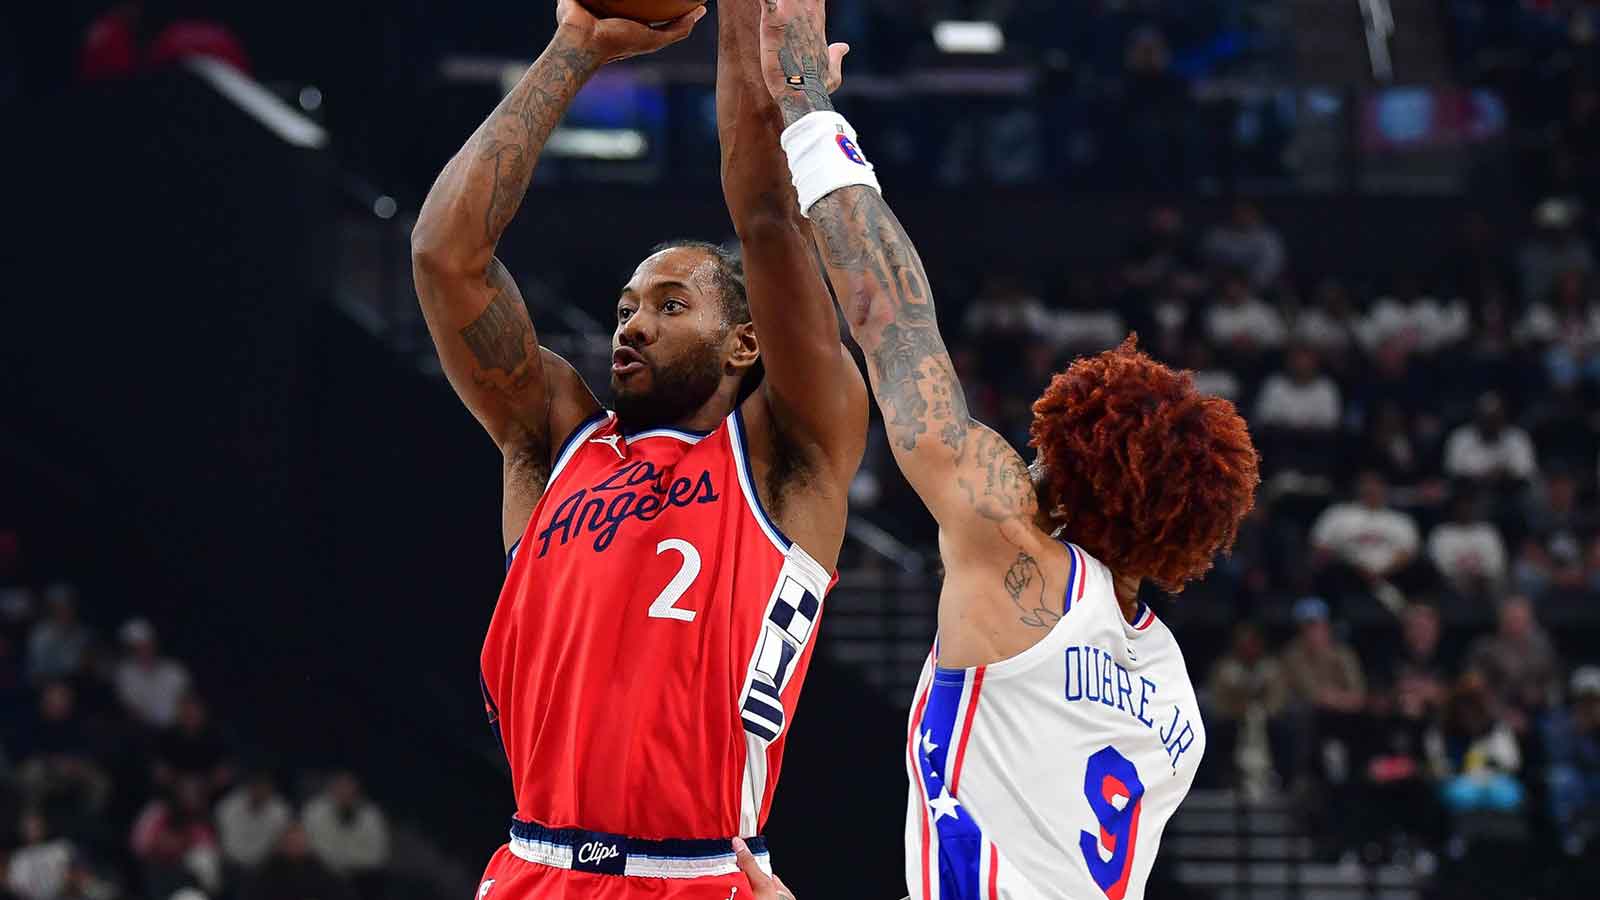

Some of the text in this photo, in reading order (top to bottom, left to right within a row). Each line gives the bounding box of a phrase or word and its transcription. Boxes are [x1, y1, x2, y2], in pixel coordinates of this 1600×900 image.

[538, 470, 720, 559] Angees
[647, 538, 702, 622] 2
[1064, 645, 1156, 728] OUBRE
[578, 841, 620, 865] Clips
[1079, 744, 1145, 900] 9
